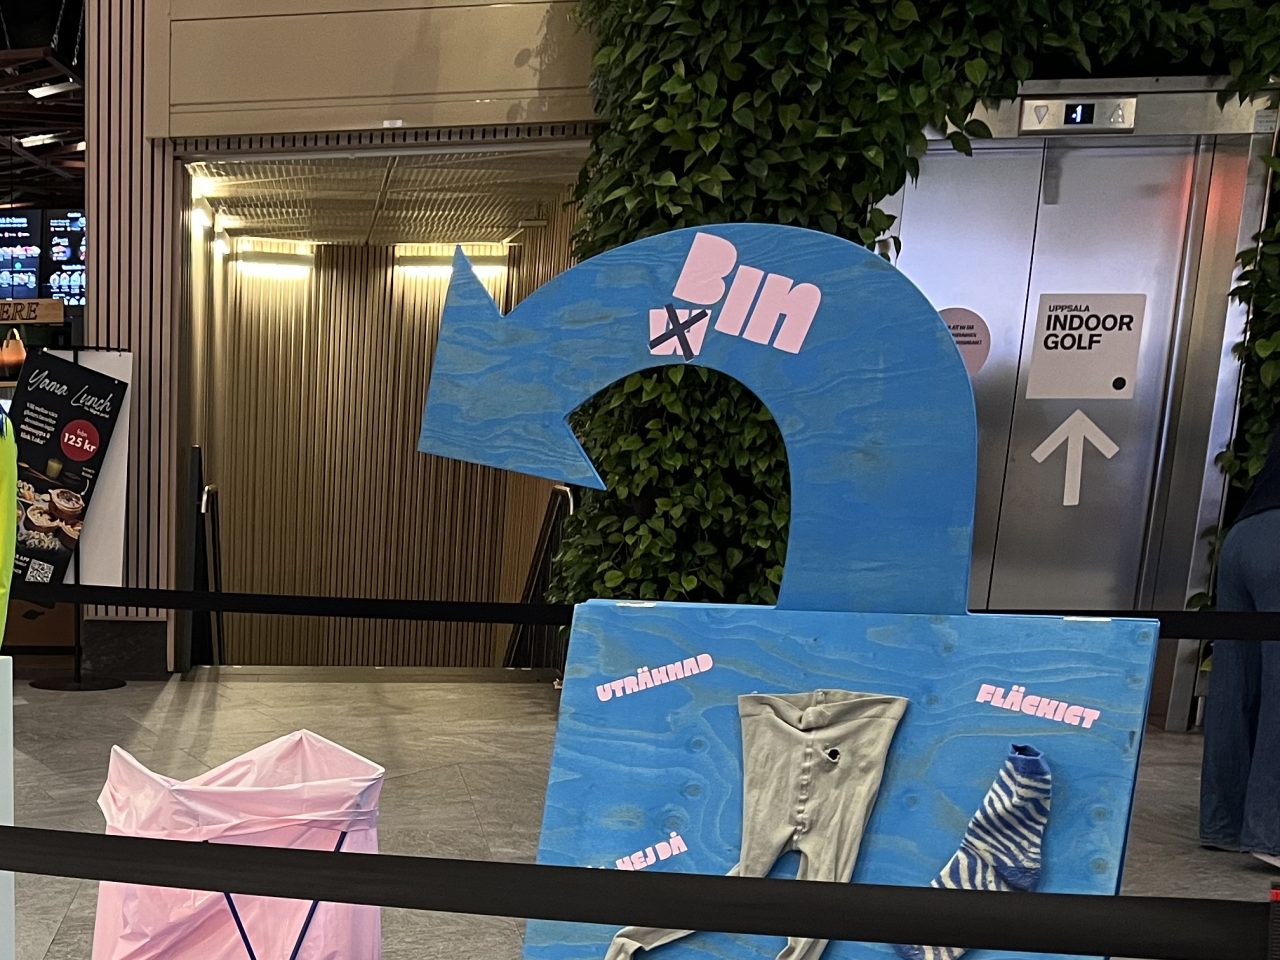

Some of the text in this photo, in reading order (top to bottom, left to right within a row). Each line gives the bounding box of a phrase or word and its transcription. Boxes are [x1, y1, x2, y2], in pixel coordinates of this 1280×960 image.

[1048, 304, 1090, 313] UPPSALA
[1046, 314, 1134, 331] INDOOR
[1043, 333, 1103, 351] GOLF
[28, 369, 68, 396] Yama
[70, 385, 113, 412] Lunch
[63, 432, 83, 448] 125
[83, 440, 97, 453] kr
[596, 653, 713, 702] UTRÄKNAD
[976, 683, 1100, 729] FLÄCKIGT
